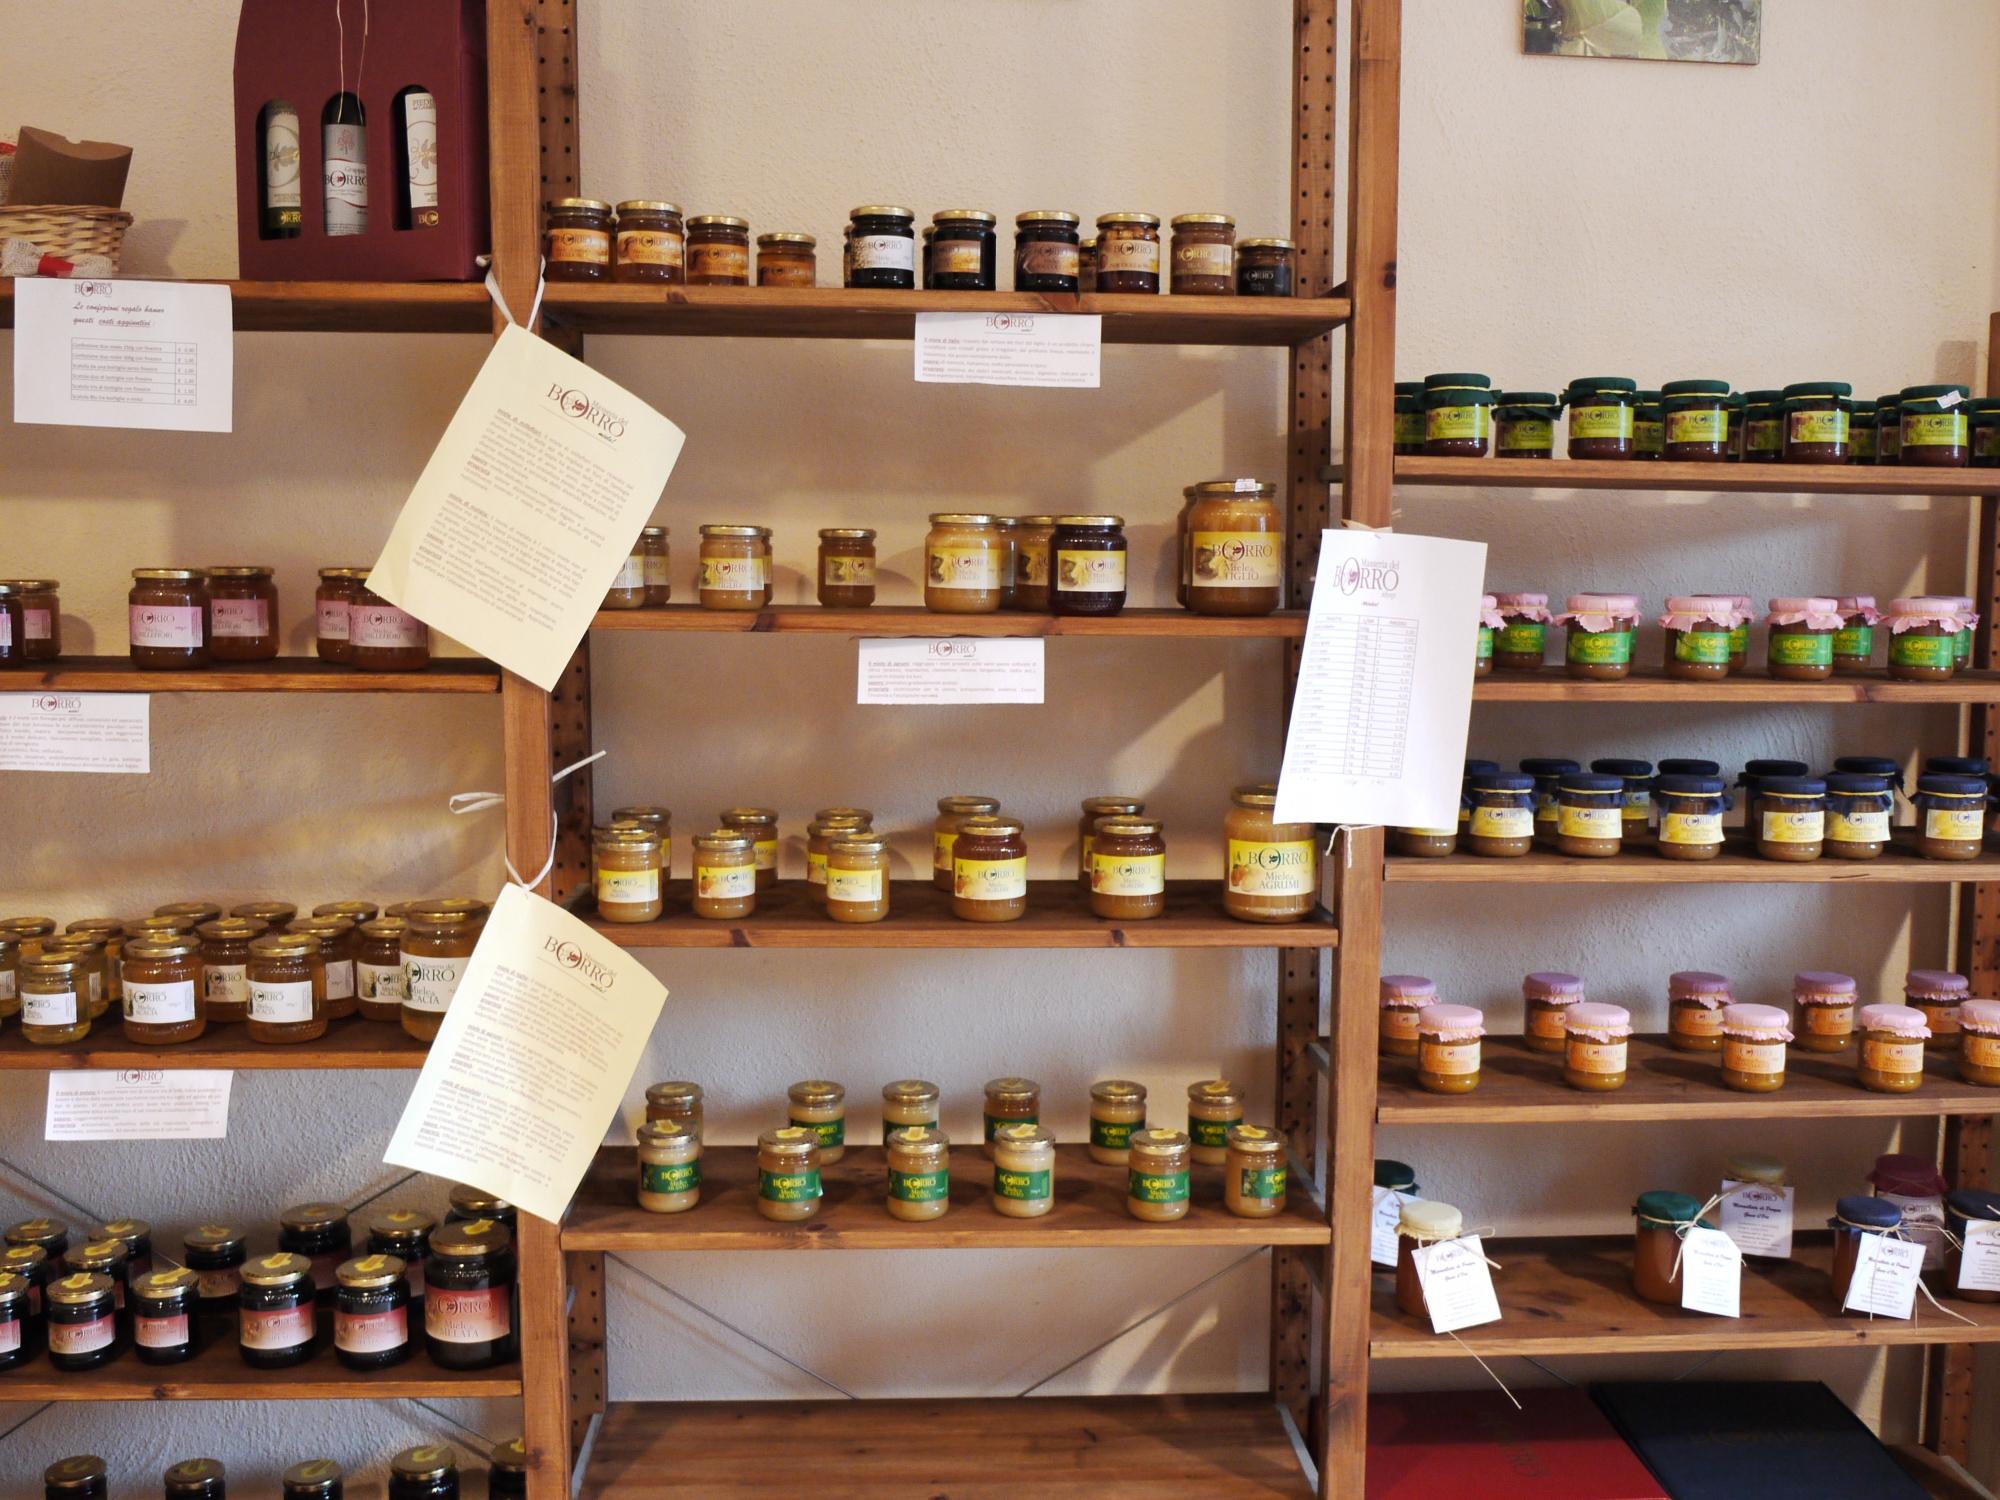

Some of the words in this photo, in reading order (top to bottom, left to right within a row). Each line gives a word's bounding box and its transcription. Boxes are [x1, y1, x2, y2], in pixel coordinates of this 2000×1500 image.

[74, 280, 113, 297] BORRO
[985, 313, 1035, 330] BORRO
[547, 383, 625, 437] BORRO
[1212, 540, 1273, 561] BORRO
[1332, 557, 1399, 596] BORRO
[928, 640, 977, 657] BORRO
[31, 695, 82, 711] BORRO
[1248, 847, 1309, 870] BORRO
[405, 961, 455, 983] ORRO
[544, 936, 614, 988] BORRO
[116, 1069, 164, 1084] BORRO
[436, 1296, 493, 1315] ORRO
